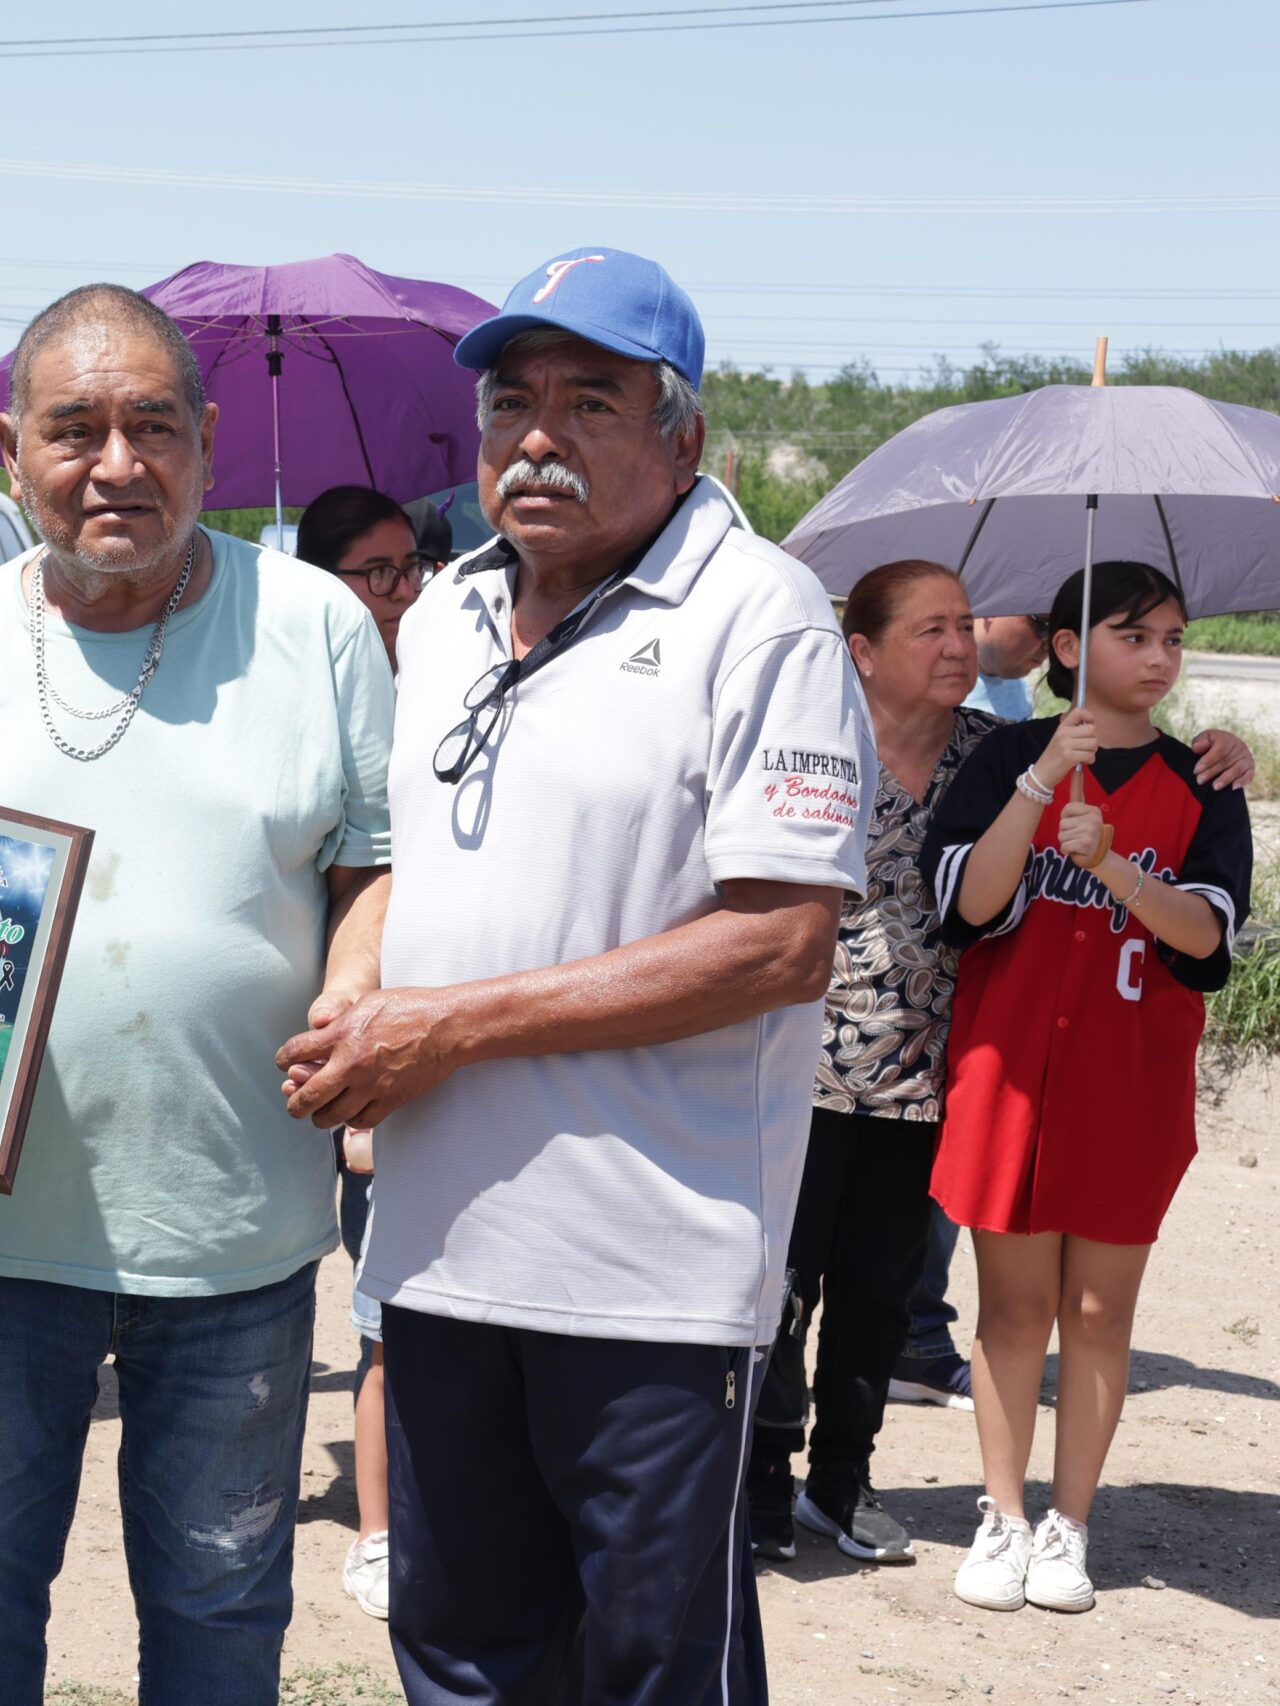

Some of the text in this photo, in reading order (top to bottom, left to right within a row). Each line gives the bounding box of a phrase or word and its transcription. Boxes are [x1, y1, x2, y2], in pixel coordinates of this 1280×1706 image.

[620, 662, 660, 677] Reebok
[763, 750, 858, 784] LA IMPRENTA
[765, 776, 858, 808] y Bordados
[773, 800, 796, 817] de
[1116, 938, 1145, 1001] C
